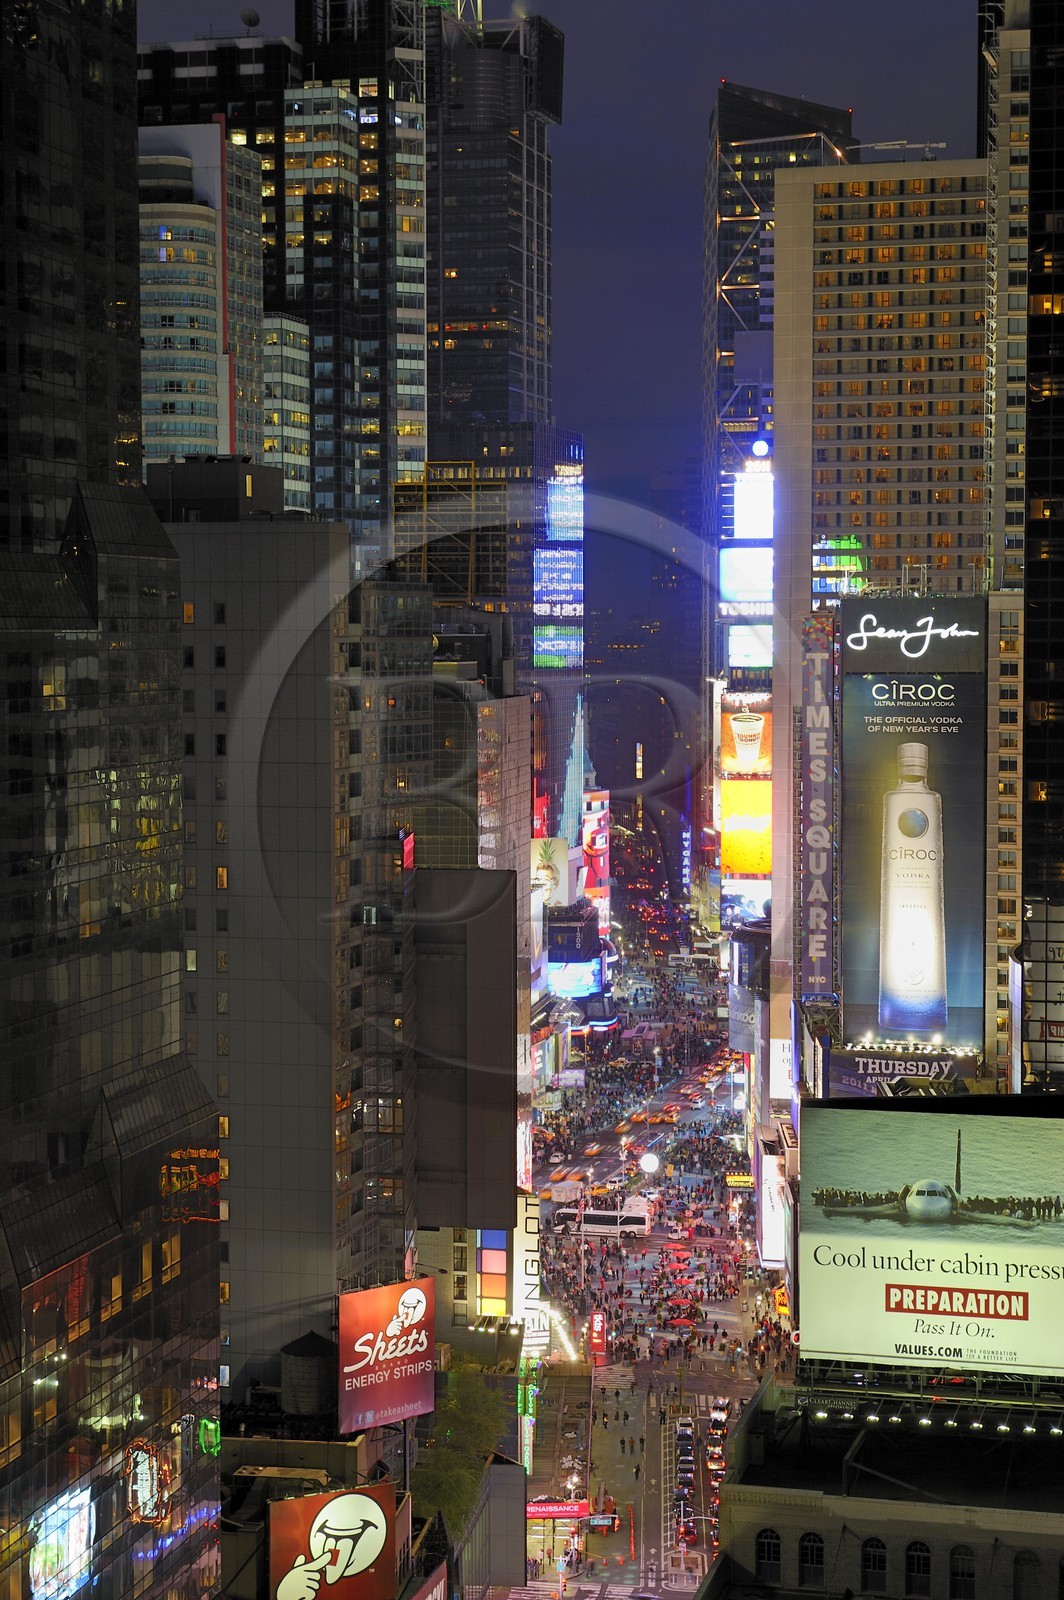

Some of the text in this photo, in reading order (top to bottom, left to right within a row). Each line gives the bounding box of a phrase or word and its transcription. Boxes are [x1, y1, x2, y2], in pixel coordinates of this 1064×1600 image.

[745, 461, 770, 472] 2011
[900, 616, 980, 658] John
[872, 680, 956, 700] CÎROC
[806, 653, 829, 782] TIMES
[890, 847, 936, 861] CÎROC
[806, 799, 830, 957] SQUARE
[855, 1057, 952, 1076] THURSDAY
[524, 1196, 540, 1310] INGLOT
[813, 1245, 866, 1268] Cool
[873, 1250, 936, 1272] under
[940, 1252, 999, 1276] cabin
[890, 1288, 1024, 1316] PREPARATION
[594, 1314, 603, 1332] tkts
[914, 1319, 945, 1336] Pass
[950, 1322, 962, 1336] It
[344, 1329, 428, 1373] Sheets
[894, 1344, 963, 1358] VALUES.COM
[375, 1358, 409, 1370] BRAND
[345, 1360, 432, 1392] ENERGY STRIPS
[526, 1505, 579, 1513] RENAISSANCE
